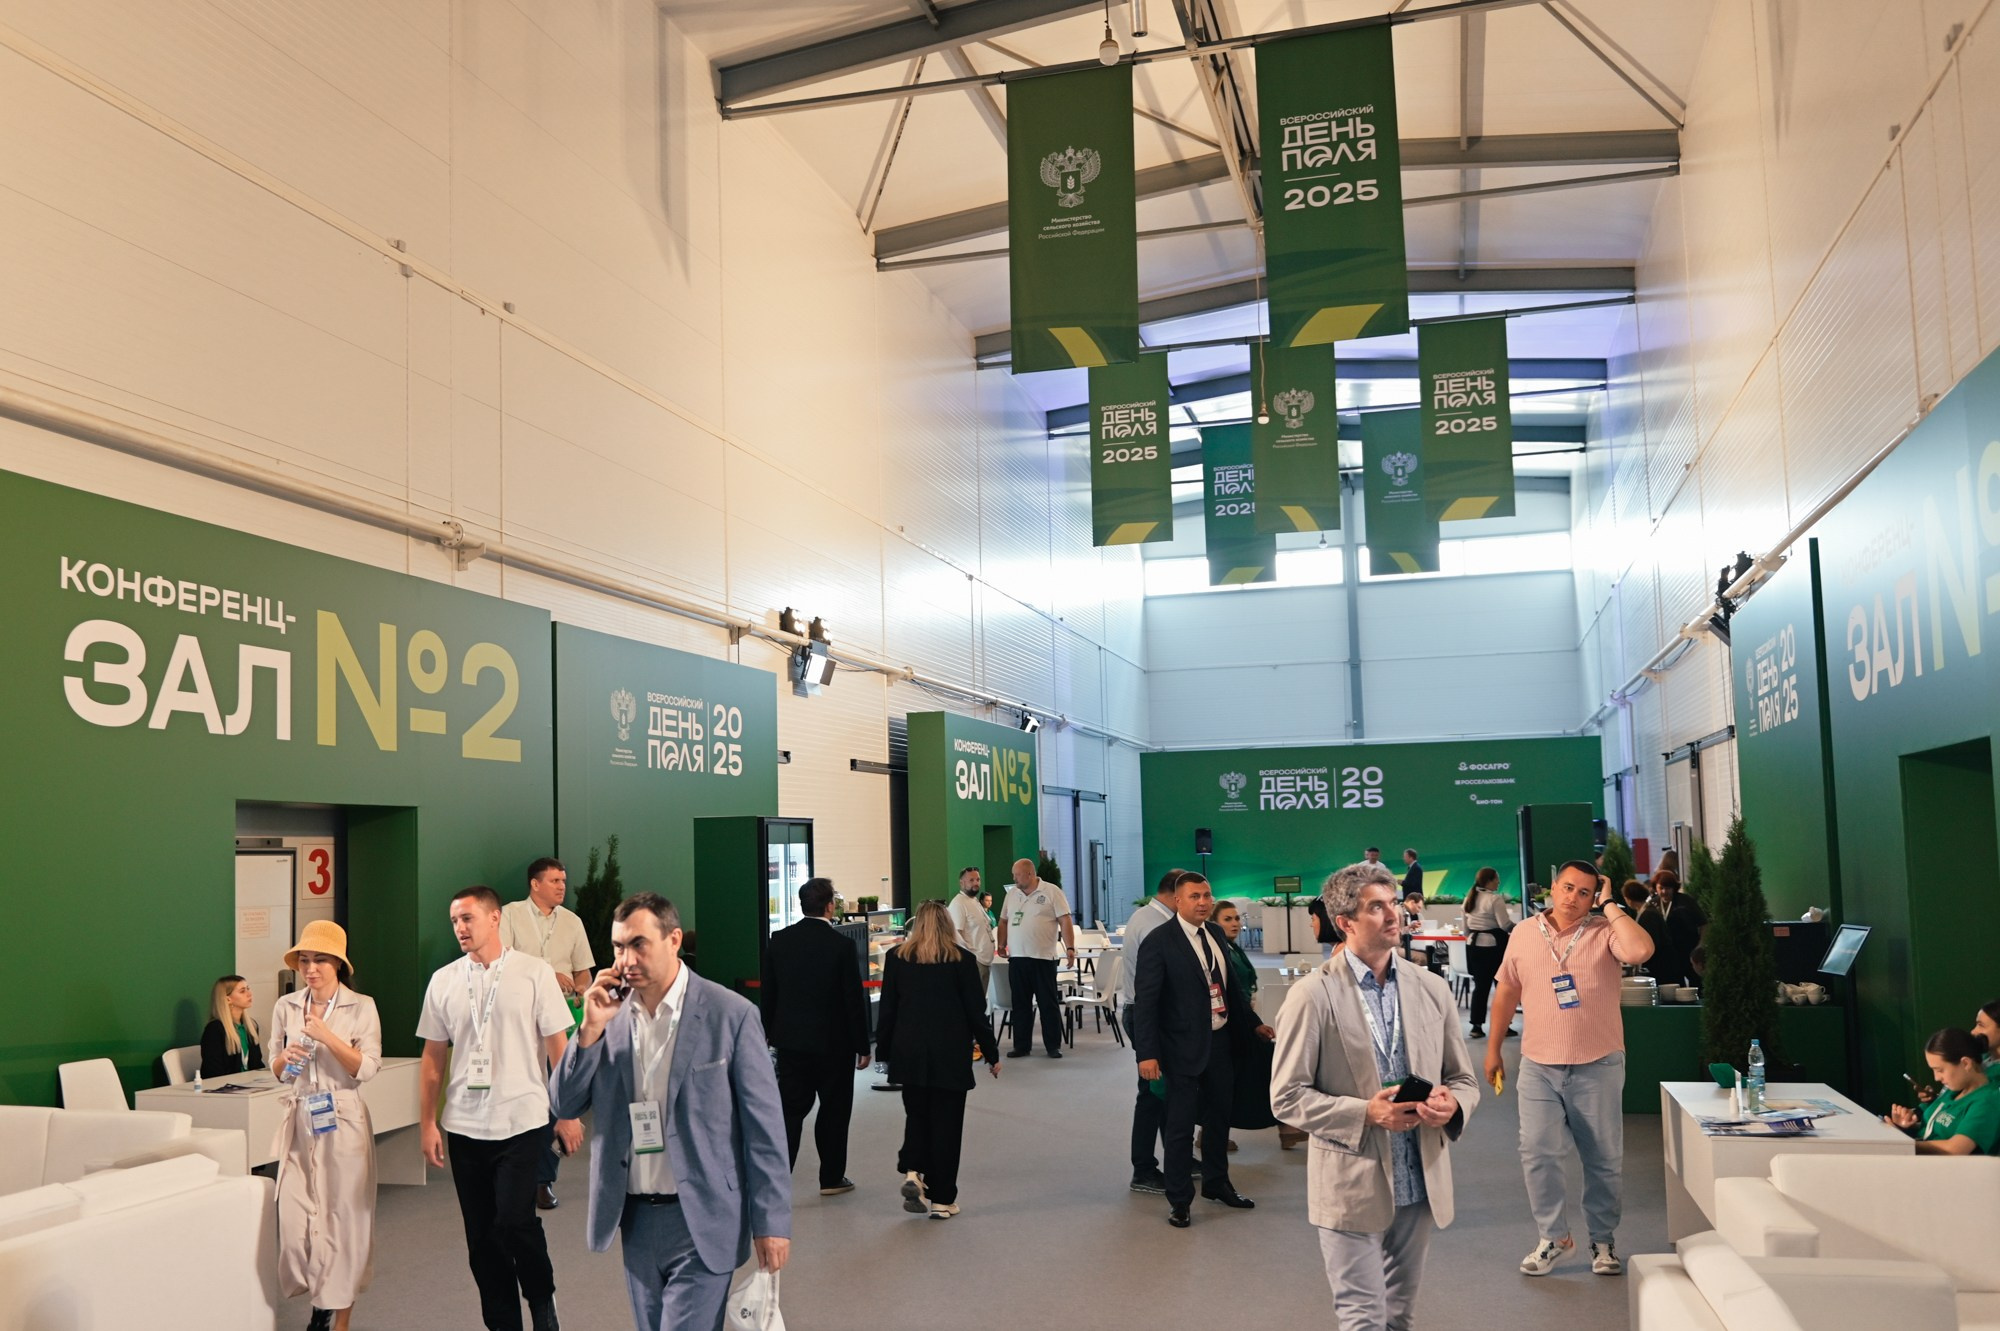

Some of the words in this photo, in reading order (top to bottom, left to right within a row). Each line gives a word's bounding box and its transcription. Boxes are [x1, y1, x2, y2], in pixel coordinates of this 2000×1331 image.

[1280, 104, 1374, 126] ВСЕРОССИЙСКИЙ
[1281, 117, 1375, 148] ДЕНЬ
[1282, 139, 1376, 171] ПОЛЯ
[1284, 179, 1379, 211] 2025
[1433, 368, 1495, 379] ВСЕРОССИЙСКИЙ
[1434, 376, 1495, 394] ДЕНЬ
[1101, 400, 1156, 411] ВСЕРОССИЙСКИЙ
[1434, 391, 1496, 409] ПОЛЯ
[1102, 408, 1157, 425] ДЕНЬ
[1435, 416, 1497, 435] 2025
[1102, 421, 1157, 439] ПОЛЯ
[1102, 446, 1158, 464] 2025
[1214, 482, 1254, 496] ПОЛ
[60, 556, 296, 634] КОНФЕРЕНЦ-
[1847, 569, 1922, 701] ЗАЛ
[1780, 623, 1796, 673] 20
[63, 619, 291, 741] ЗАЛ
[647, 691, 703, 710] ВСЕРОССИЙСКИЙ
[1783, 674, 1799, 723] 25
[647, 706, 704, 741] ДЕНЬ
[713, 704, 743, 739] 20
[648, 739, 704, 773] ПОЛЯ
[713, 741, 743, 777] 25
[955, 759, 991, 801] ЗАЛ
[1259, 767, 1328, 776] ВСЕРОССИЙСКИЙ
[1342, 766, 1383, 786] 20
[1260, 775, 1328, 793] ДЕНЬ
[1260, 793, 1329, 810] ПОЛЯ
[1342, 788, 1384, 808] 25
[308, 848, 331, 895] 3
